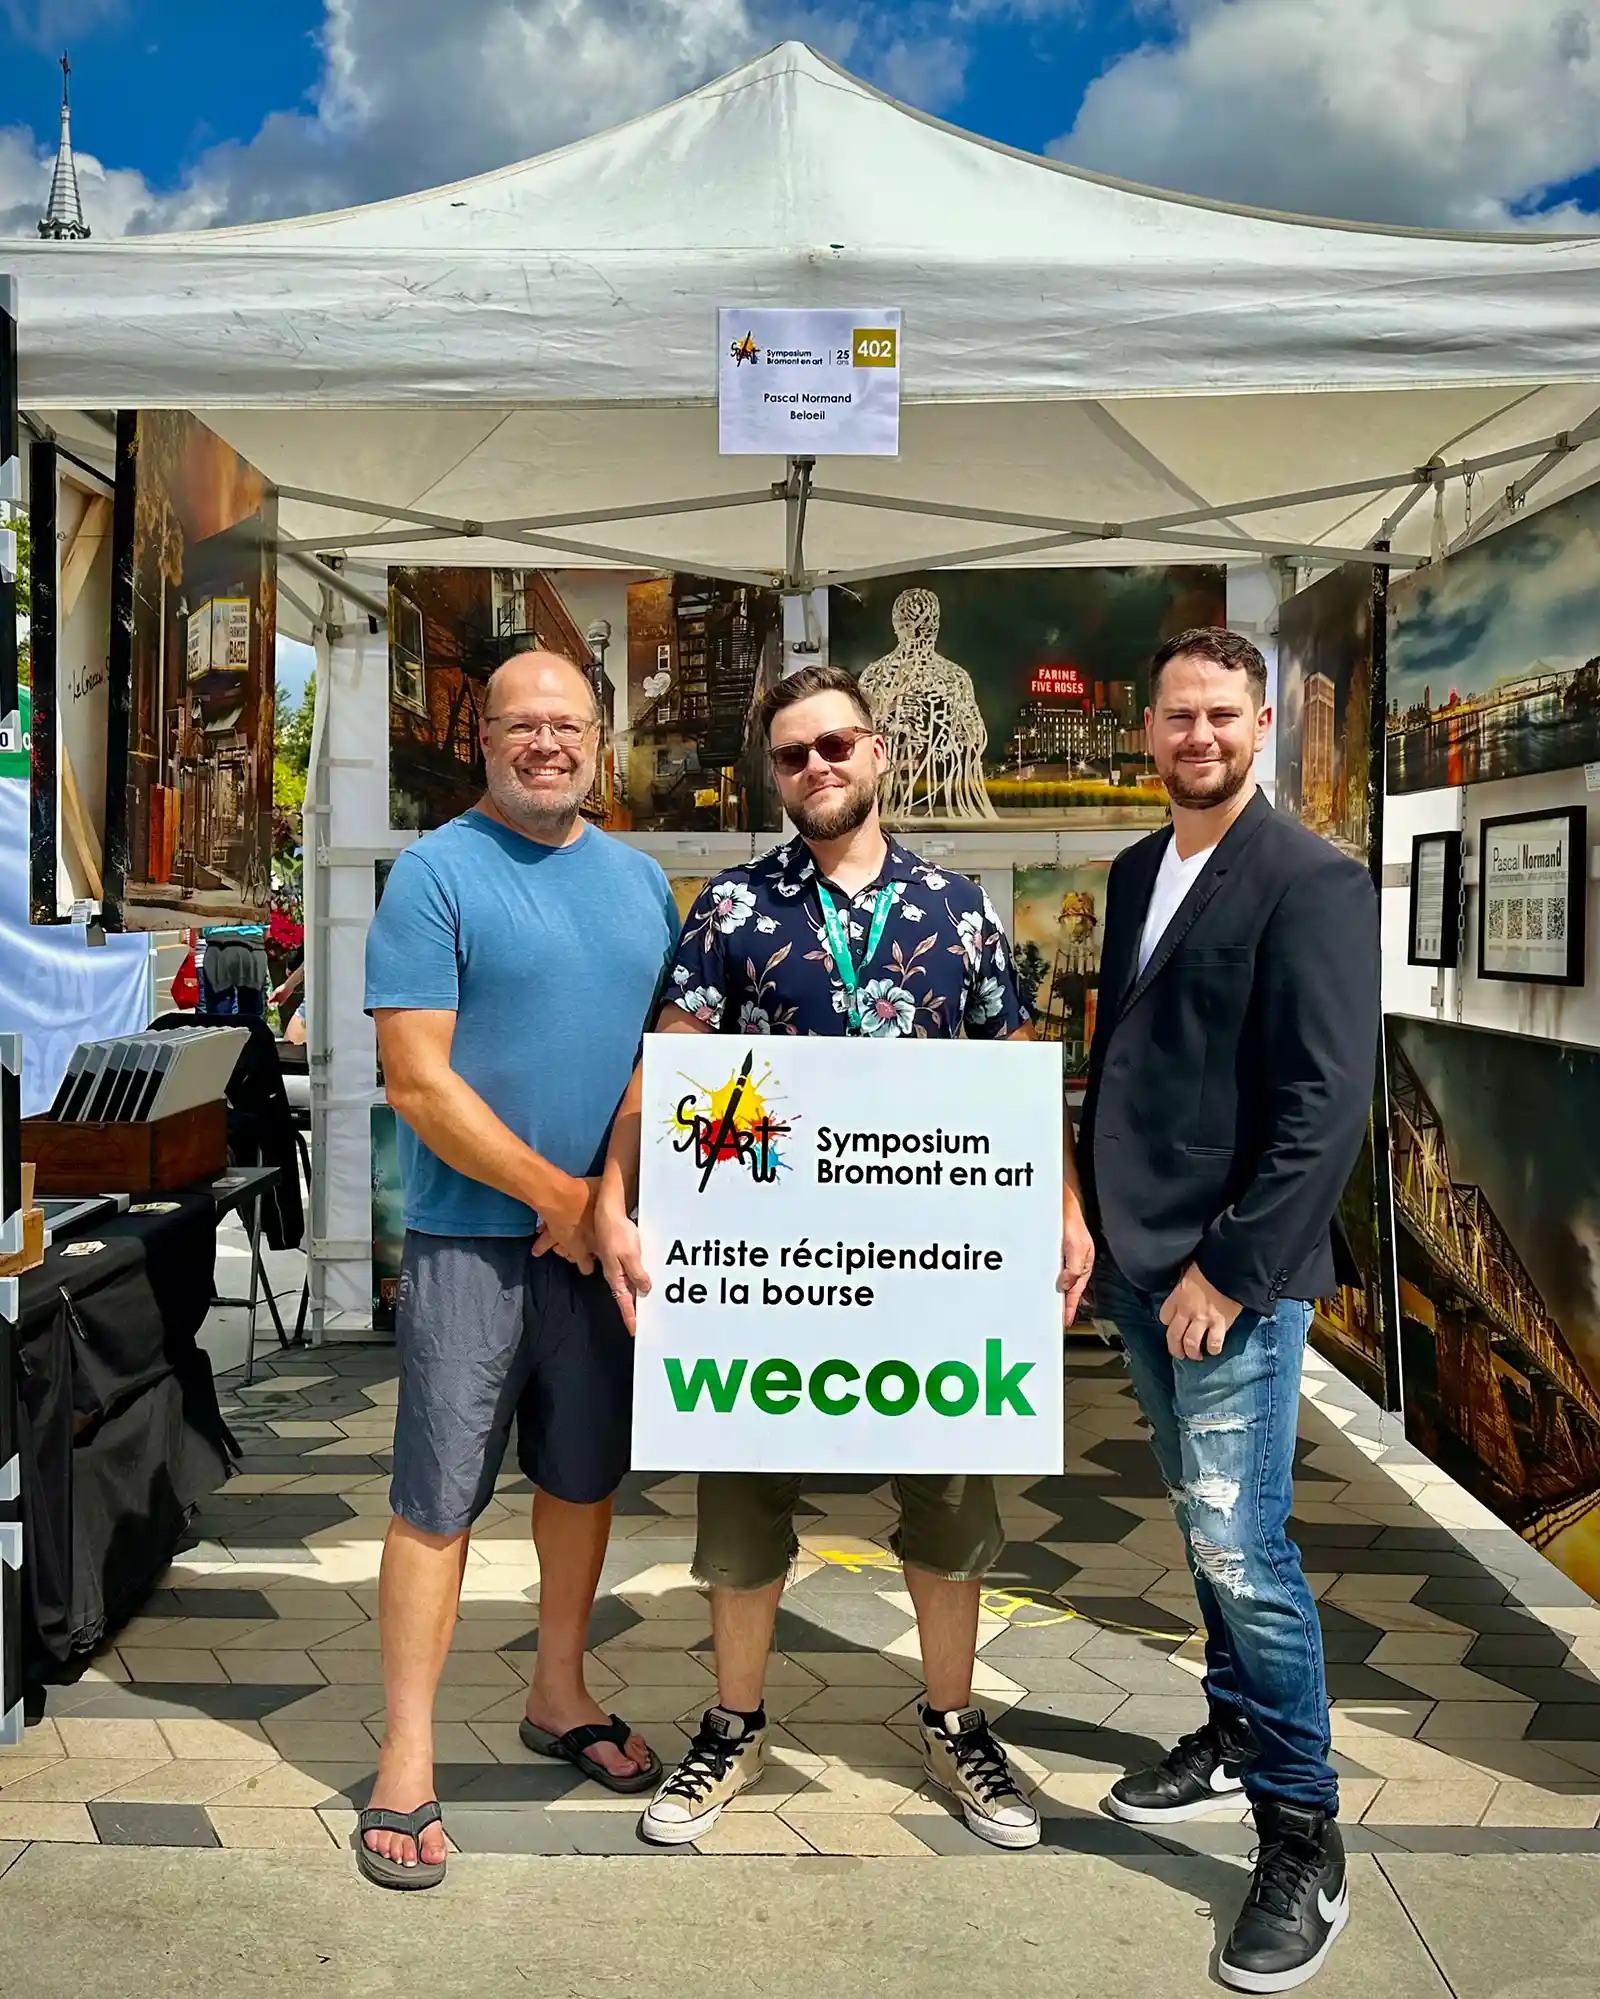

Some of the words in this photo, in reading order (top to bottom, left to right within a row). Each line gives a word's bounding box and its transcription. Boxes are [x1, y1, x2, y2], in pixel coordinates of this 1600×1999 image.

[766, 349, 812, 359] Symposium
[837, 350, 850, 360] 25
[857, 340, 892, 358] 402
[766, 357, 800, 366] Bromont
[800, 358, 811, 366] en
[812, 357, 823, 366] art
[763, 393, 799, 404] Pascal
[802, 393, 852, 404] Normand
[790, 411, 826, 421] Beloeil
[1038, 669, 1077, 681] FARINE
[1031, 680, 1052, 693] FIVE
[1054, 681, 1084, 694] ROSES
[1492, 844, 1520, 872] Pascal
[1522, 839, 1562, 870] Normand
[816, 1126, 990, 1159] Symposium
[816, 1158, 943, 1187] Bromont
[949, 1163, 988, 1187] en
[994, 1163, 1034, 1188] art
[665, 1239, 769, 1268] Artiste
[780, 1237, 1003, 1275] récipiendaire
[664, 1276, 708, 1305] de
[720, 1278, 750, 1305] la
[763, 1279, 875, 1308] bourse
[662, 1338, 1038, 1417] wecook
